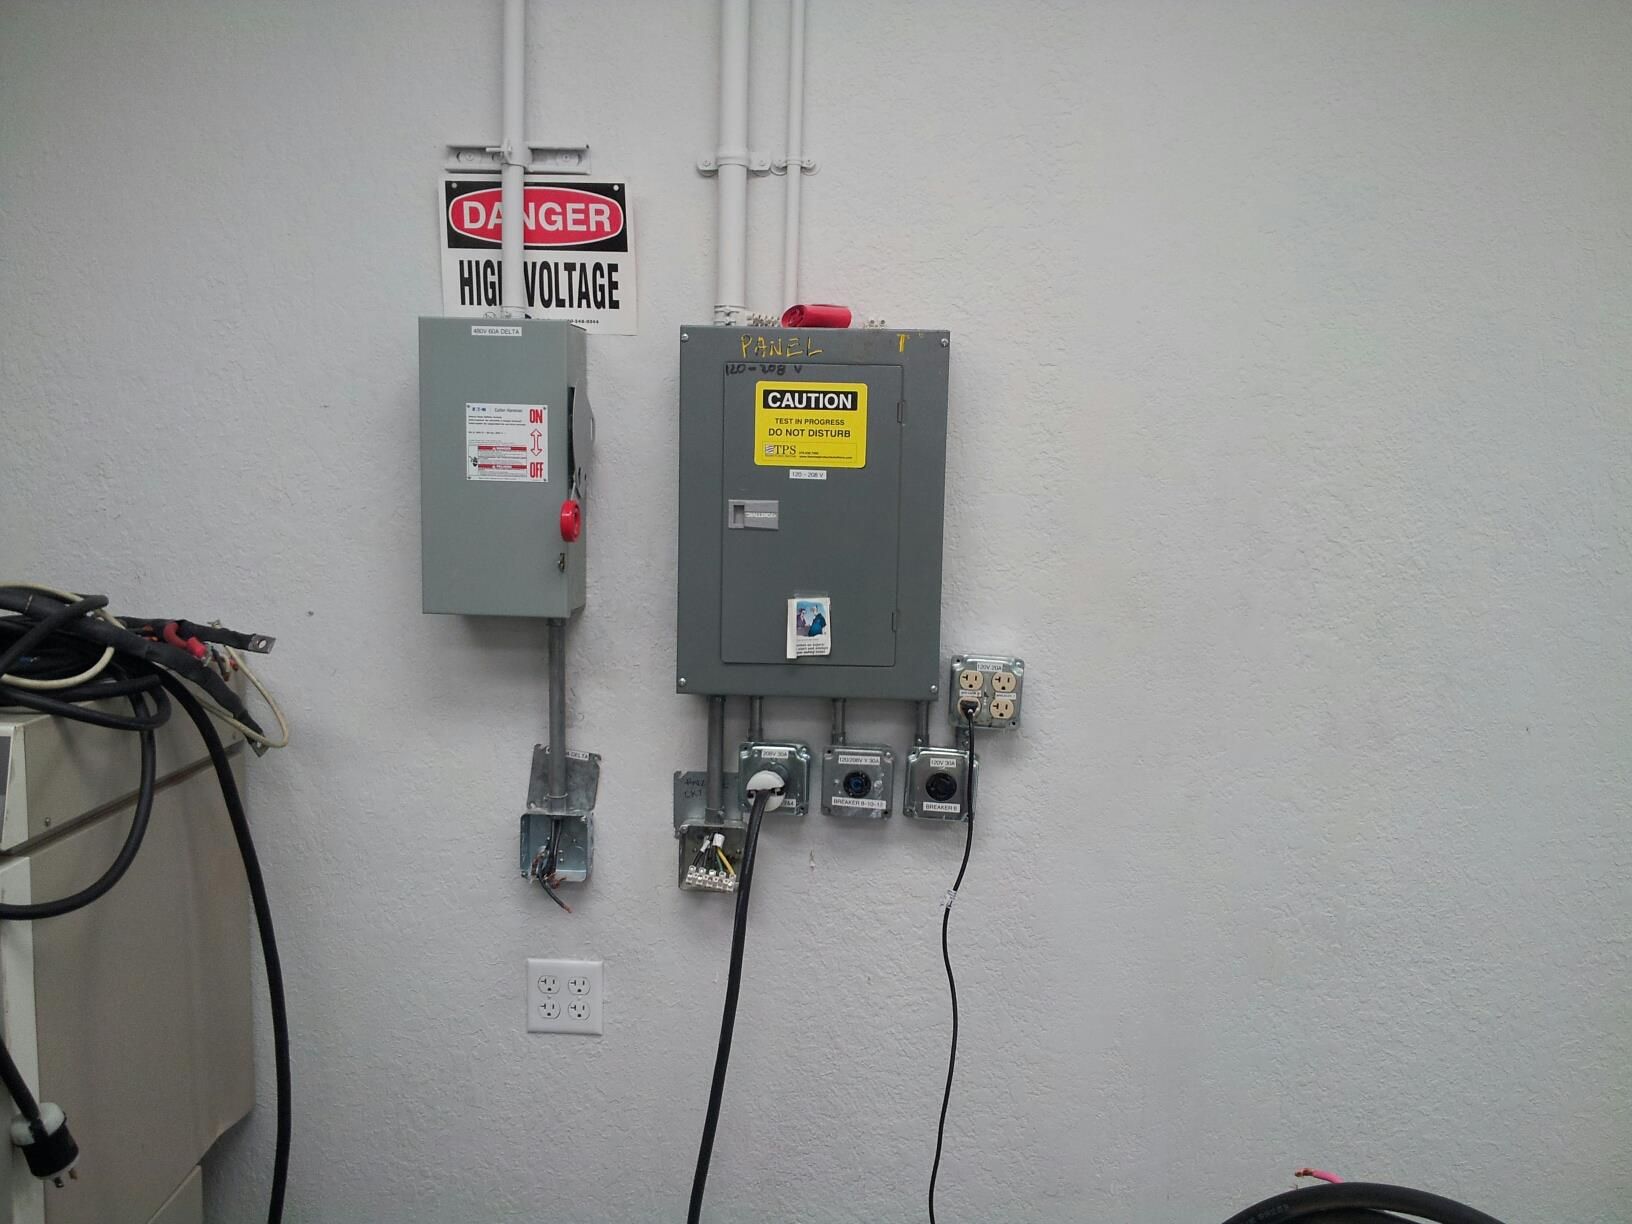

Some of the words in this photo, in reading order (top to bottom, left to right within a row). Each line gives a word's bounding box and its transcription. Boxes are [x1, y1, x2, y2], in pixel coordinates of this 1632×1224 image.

[463, 201, 611, 232] DANGER
[523, 261, 620, 310] VOLTAGE
[500, 328, 520, 336] DELTA
[740, 334, 824, 358] PANEL
[767, 391, 852, 409] CAUTION
[529, 409, 543, 424] ON
[775, 417, 795, 425] TEST
[804, 418, 845, 426] PROGRESS
[768, 428, 784, 437] DO
[786, 428, 805, 437] NOT
[808, 428, 851, 438] DISTURB
[774, 444, 797, 455] TPS
[529, 462, 544, 478] OFF
